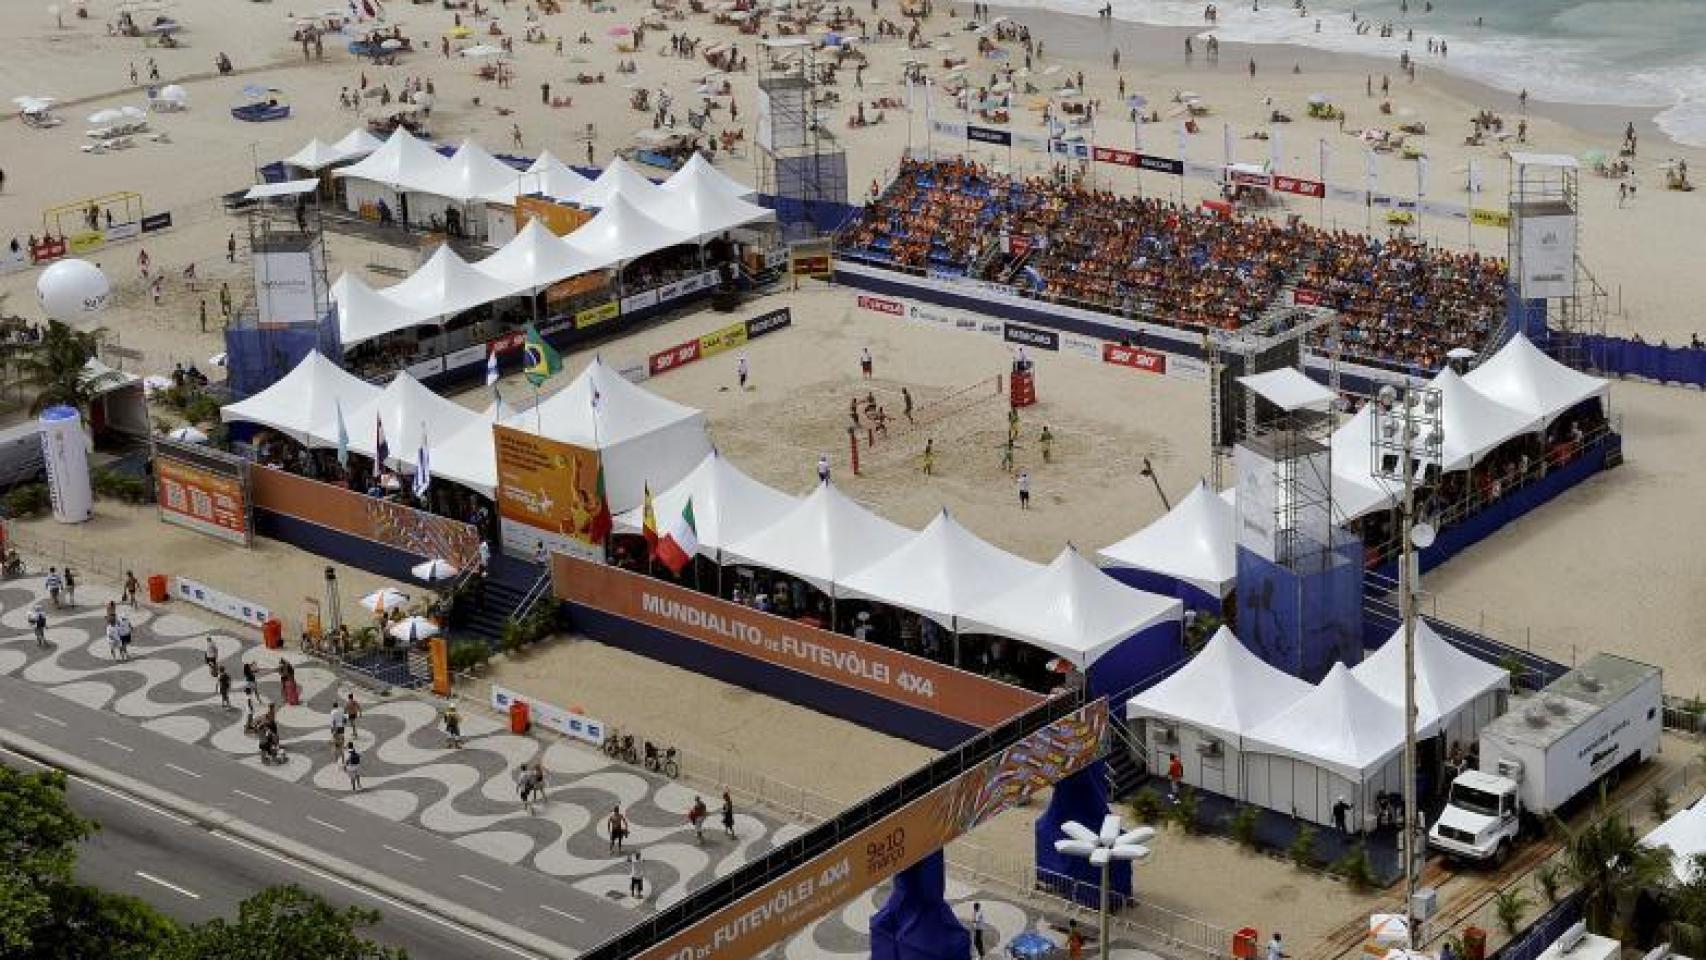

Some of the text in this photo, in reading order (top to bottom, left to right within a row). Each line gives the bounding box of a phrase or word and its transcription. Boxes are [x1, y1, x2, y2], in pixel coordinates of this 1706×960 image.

[642, 592, 762, 645] MUNDIALITO
[781, 635, 890, 684] FUTEVÔLEI
[714, 878, 814, 949] FUTEVÔLEI
